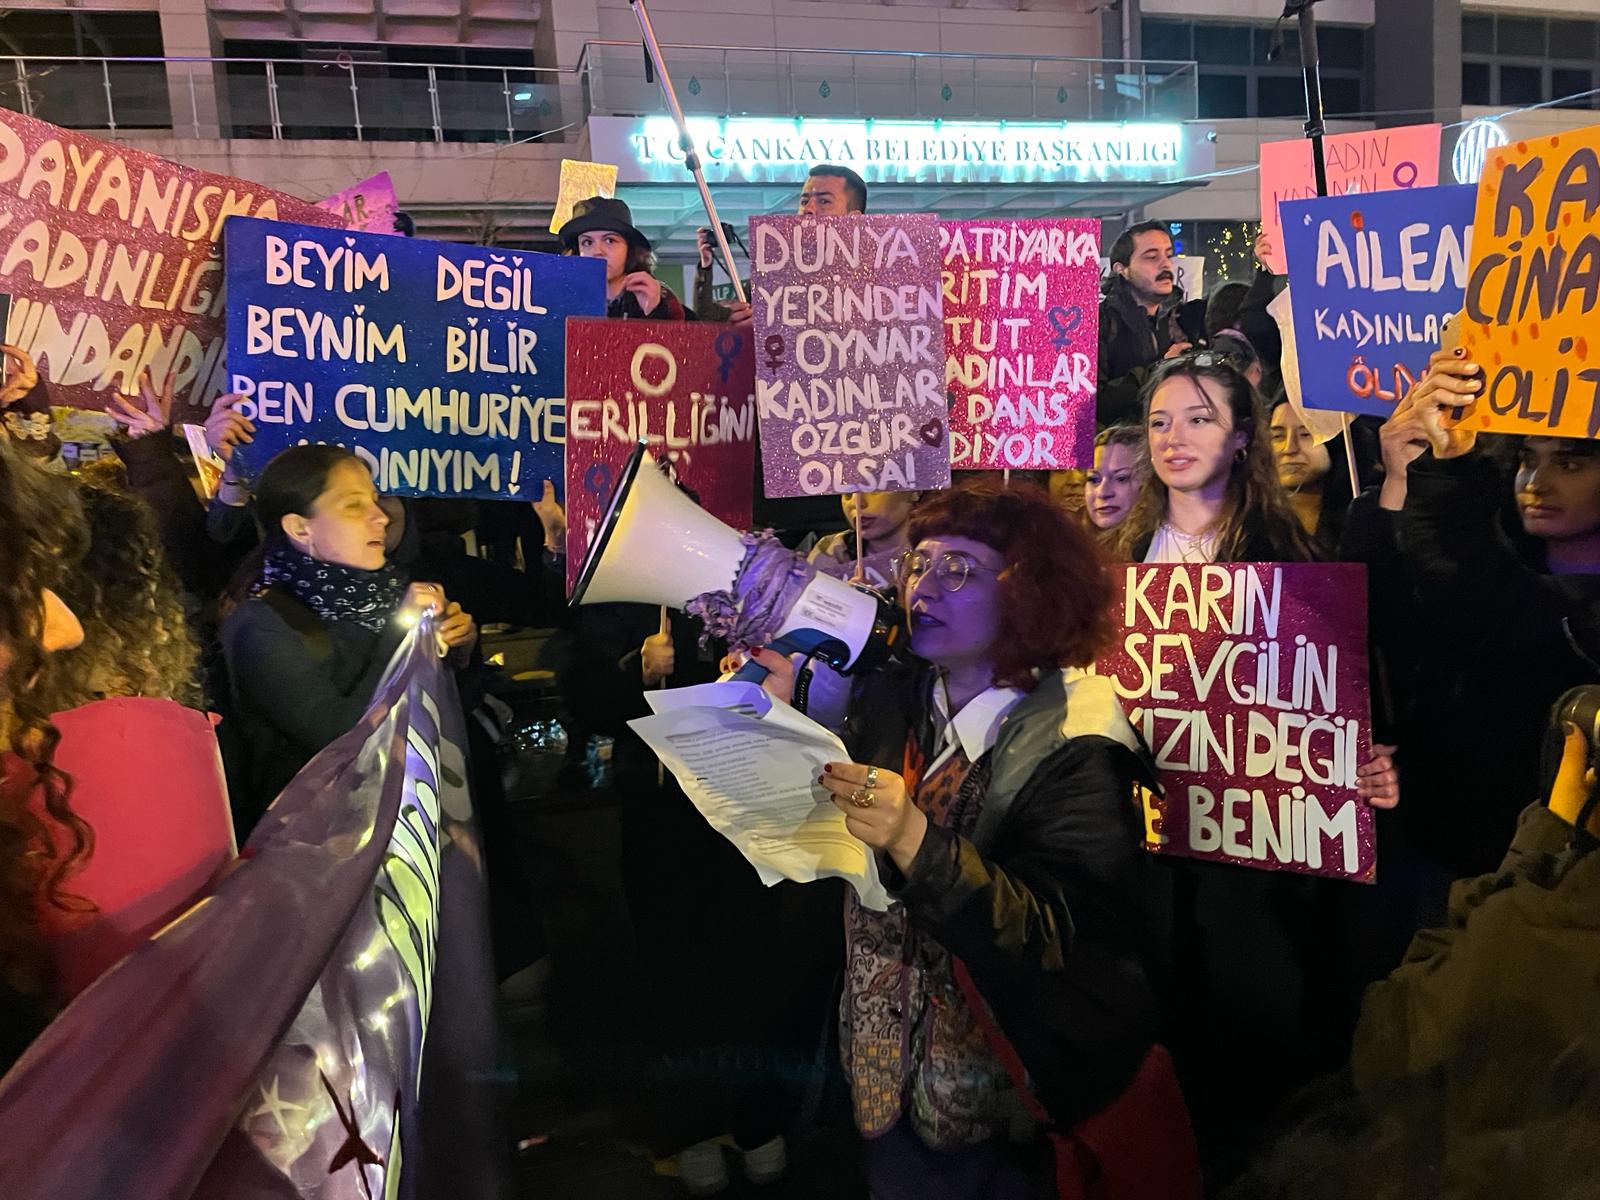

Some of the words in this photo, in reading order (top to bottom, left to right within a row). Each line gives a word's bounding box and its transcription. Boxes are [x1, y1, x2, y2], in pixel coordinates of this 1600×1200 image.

[706, 136, 856, 166] ÇANKAYA
[866, 135, 1007, 161] BELEDİYE
[1308, 136, 1389, 178] ADIN
[1494, 147, 1600, 238] KA
[755, 219, 920, 272] DÜNYA
[265, 235, 390, 293] BEYİM
[436, 253, 548, 315] DEĞİL
[758, 274, 943, 327] YERİNDEN
[940, 265, 1047, 311] RİTİM
[1466, 233, 1600, 326] CİNA
[247, 303, 407, 364] BEYNİM
[446, 316, 538, 375] BİLİR
[795, 325, 935, 374] OYNAR
[944, 316, 1031, 352] TUT
[630, 342, 677, 397] O
[757, 368, 945, 422] KADINLAR
[1347, 355, 1427, 400] ÖLD
[232, 374, 313, 425] BEN
[334, 383, 566, 444] CUMHURİYE
[570, 391, 755, 448] ERİLLİĞİNİ
[791, 412, 921, 457] ÖZGÜR
[967, 390, 1068, 427] DANS
[297, 438, 521, 495] DINIYIM!
[799, 452, 916, 494] OLSA!
[1125, 564, 1282, 638] KARIN
[1110, 633, 1338, 713] SEVGİLİN
[1128, 707, 1235, 775] IZIN
[1245, 710, 1359, 789] DEĞİL
[1188, 785, 1359, 874] BENİM
